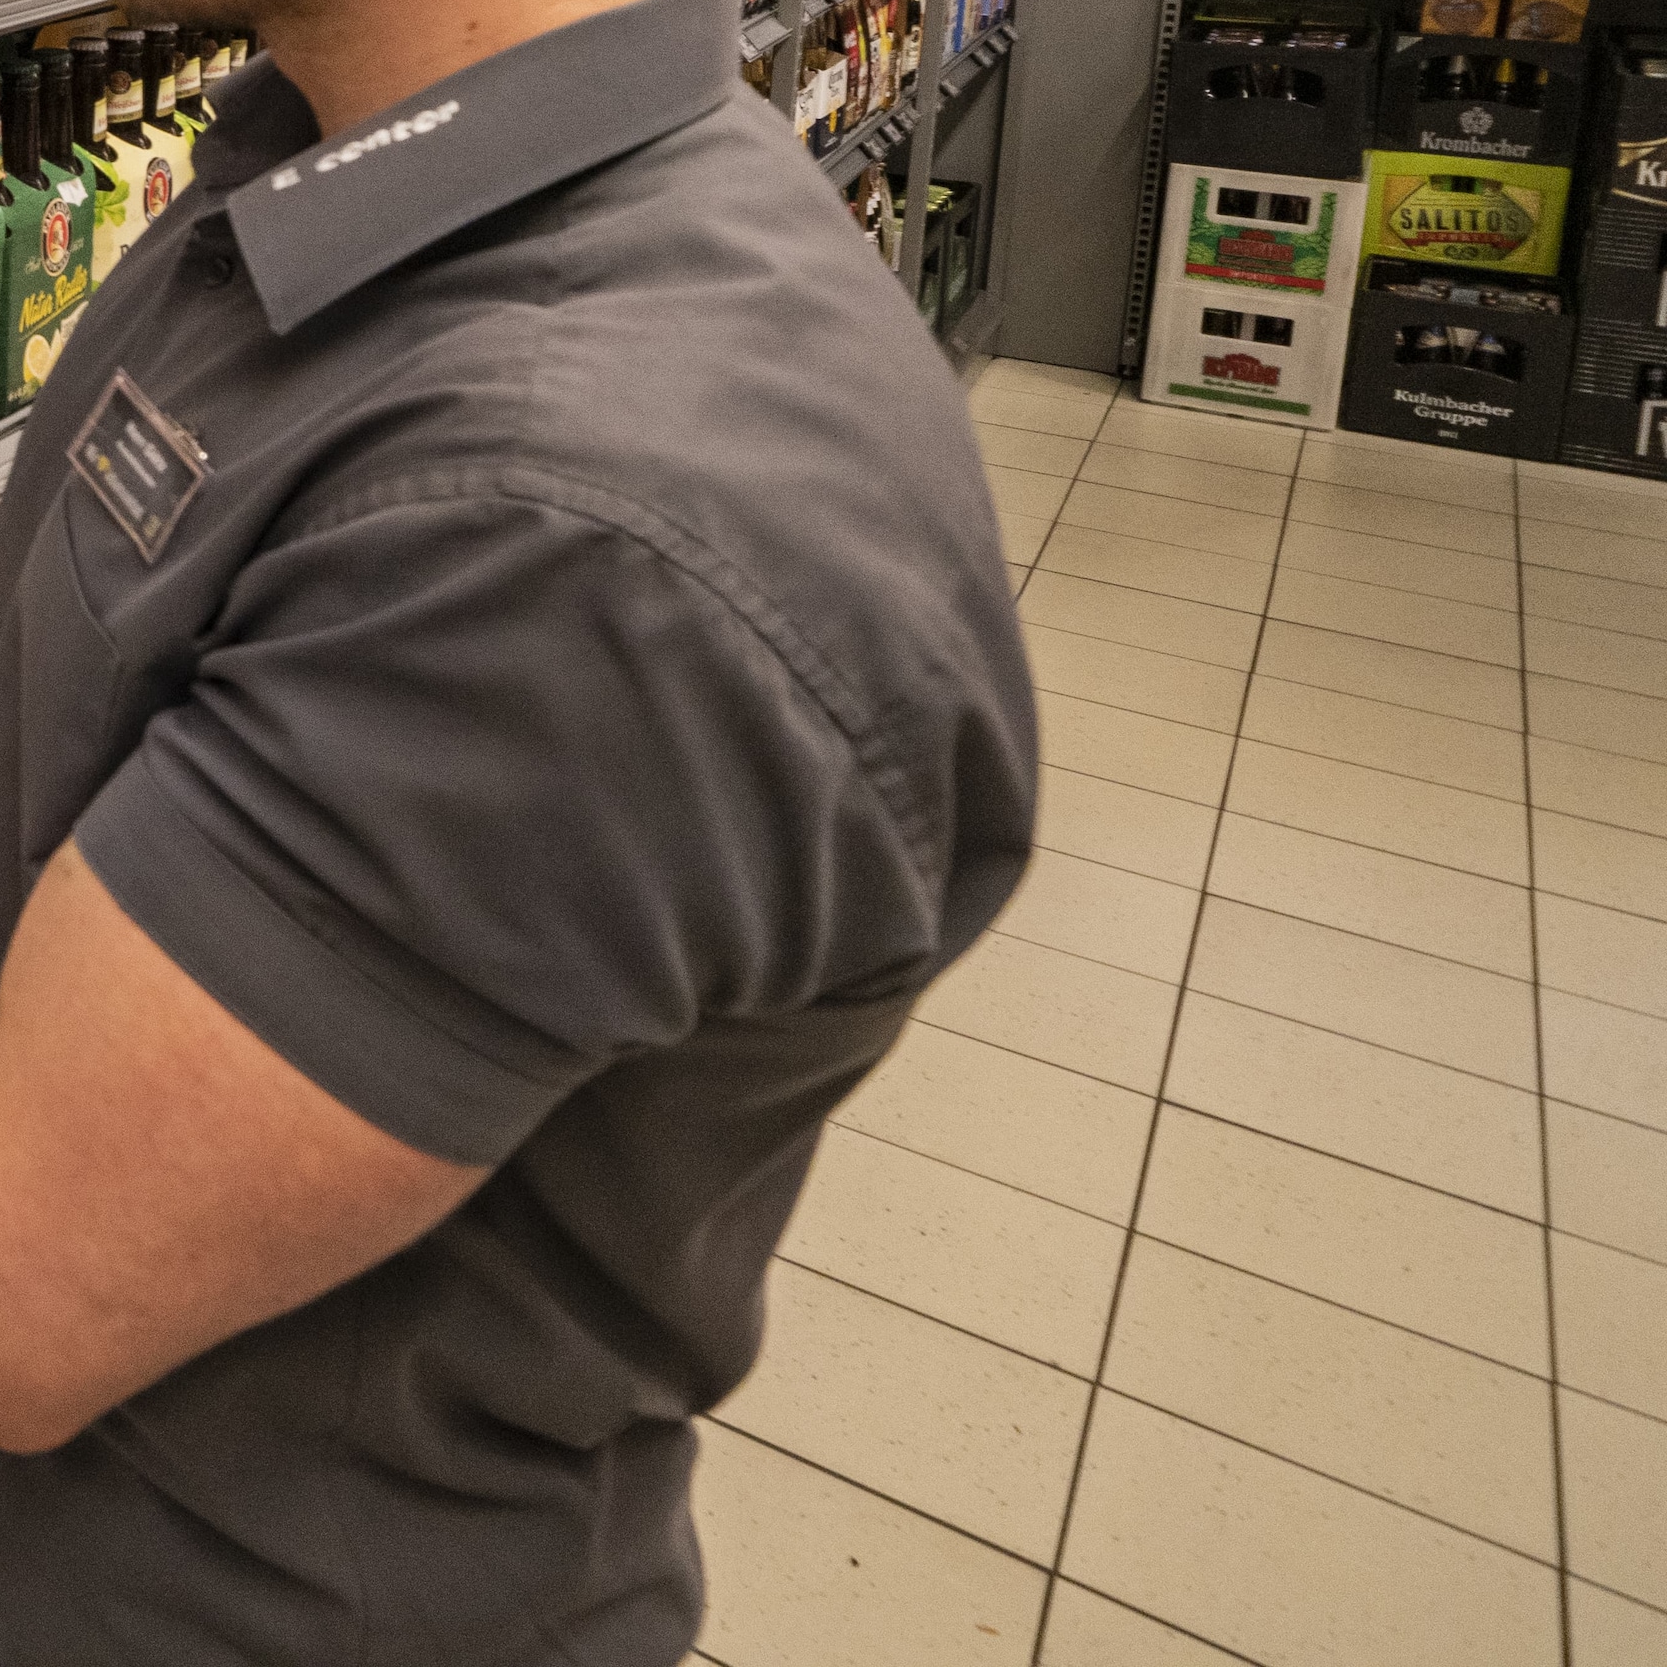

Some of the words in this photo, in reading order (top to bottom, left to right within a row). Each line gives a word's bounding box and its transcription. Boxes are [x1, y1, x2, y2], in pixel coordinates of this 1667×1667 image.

[1419, 130, 1533, 160] Krombacher
[1400, 206, 1517, 233] SALITOS
[1393, 388, 1515, 419] Kulmbacher
[1413, 405, 1489, 429] Gruppe
